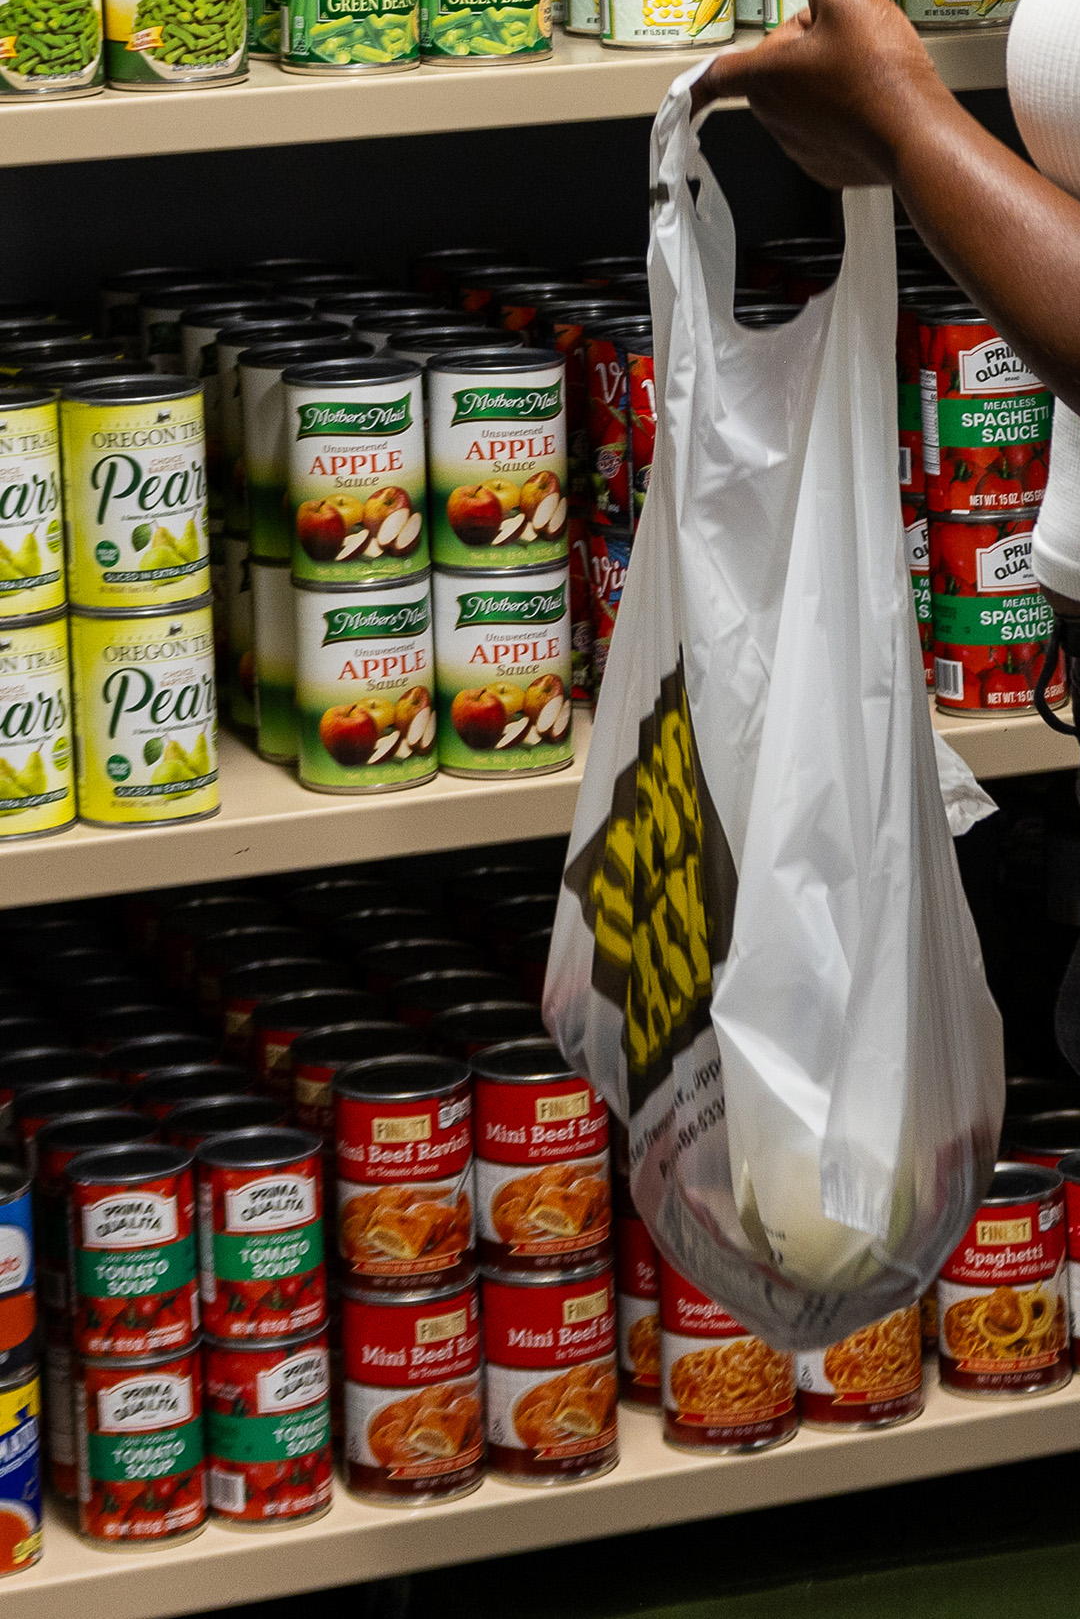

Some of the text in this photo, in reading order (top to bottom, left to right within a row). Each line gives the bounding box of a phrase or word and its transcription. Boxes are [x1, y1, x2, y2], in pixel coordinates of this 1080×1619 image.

[983, 398, 1036, 410] MEATLESS
[302, 404, 406, 430] Mother's Maid
[961, 405, 1049, 427] SPAGHETTI
[482, 426, 544, 438] Unsweetened
[981, 424, 1039, 443] SAUCE
[323, 442, 388, 454] Unsweetened
[465, 435, 556, 460] APPLE
[309, 450, 404, 476] APPLE
[492, 460, 536, 472] Sauce
[334, 476, 380, 488] Sauce
[485, 630, 548, 642] Unsweetened
[103, 641, 187, 663] OREGON
[469, 637, 560, 663] APPLE
[338, 649, 426, 680] APPLE
[496, 664, 540, 676] Sauce
[366, 677, 409, 692] Sauce
[987, 690, 1026, 704] NET WT. 15
[368, 1142, 414, 1163] Beef
[417, 1128, 469, 1161] Ravioli
[249, 1184, 298, 1203] PRIMA
[104, 1203, 155, 1217] PRIMA
[238, 1239, 311, 1263] TOMATO
[964, 1243, 1043, 1269] Spaghetti
[95, 1258, 169, 1281] TOMATO
[251, 1259, 301, 1278] SOUP
[106, 1278, 159, 1297] SOUP
[508, 1323, 598, 1348] Mini Beef
[362, 1343, 454, 1367] Mini Beef
